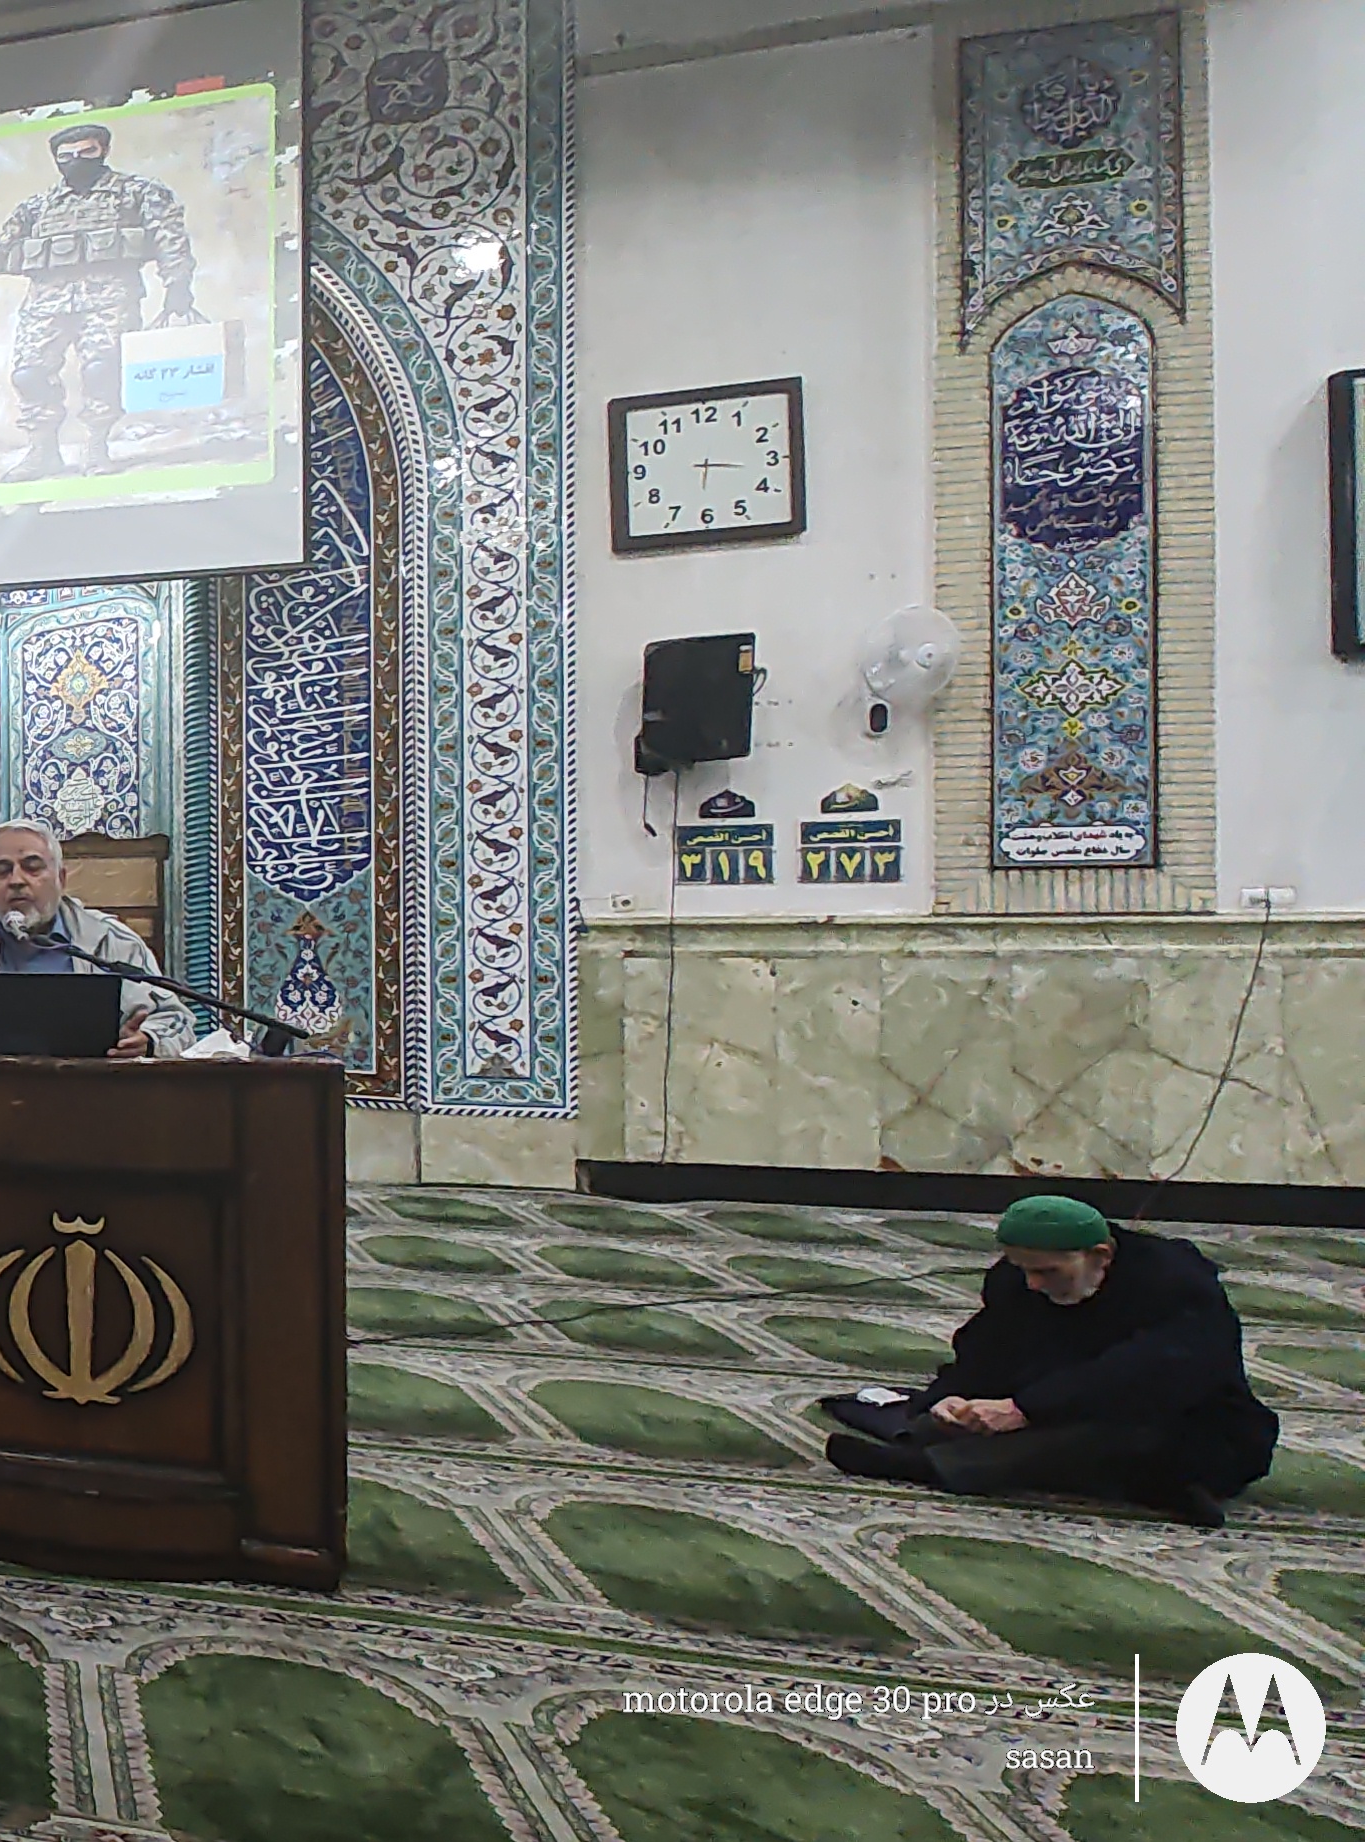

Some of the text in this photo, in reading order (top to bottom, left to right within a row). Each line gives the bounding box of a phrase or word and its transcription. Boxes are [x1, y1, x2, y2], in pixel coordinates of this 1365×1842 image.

[690, 406, 718, 424] 12
[731, 410, 742, 427] 1
[658, 417, 682, 435] 11
[755, 426, 770, 444] 2
[638, 438, 666, 457] 10
[766, 450, 780, 467] 3
[633, 464, 646, 480] 9
[754, 477, 770, 493] 4
[648, 488, 661, 504] 8
[668, 505, 682, 522] 7
[700, 508, 714, 524] 6
[733, 499, 747, 516] 5
[1073, 830, 1107, 841] شهدای
[1110, 846, 1131, 856] سال
